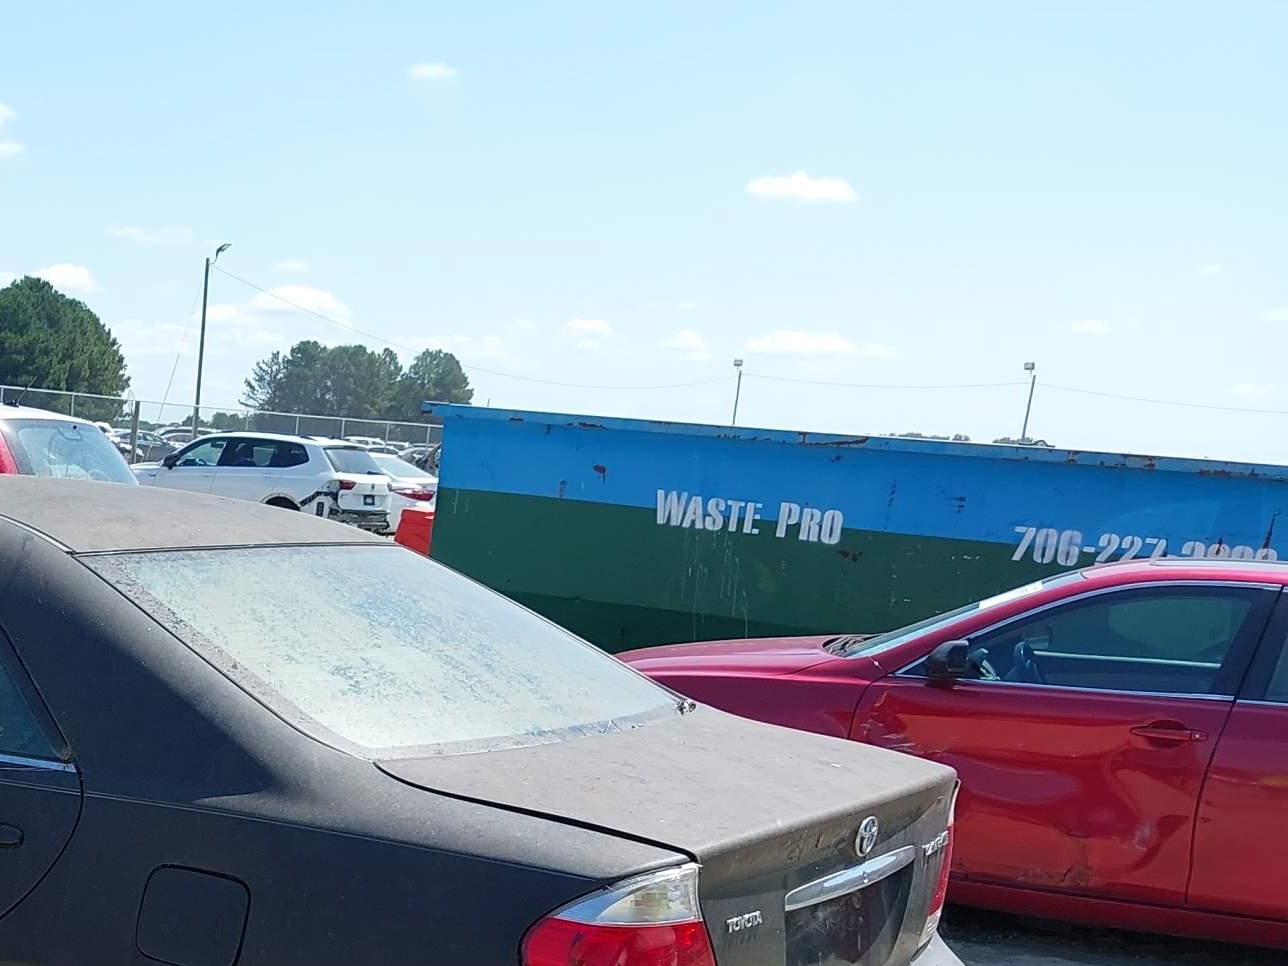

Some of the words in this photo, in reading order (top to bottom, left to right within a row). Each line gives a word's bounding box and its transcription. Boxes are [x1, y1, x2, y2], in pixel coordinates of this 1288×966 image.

[656, 489, 763, 534] WASTE
[775, 502, 843, 544] PRO
[726, 910, 763, 934] TOYOTA
